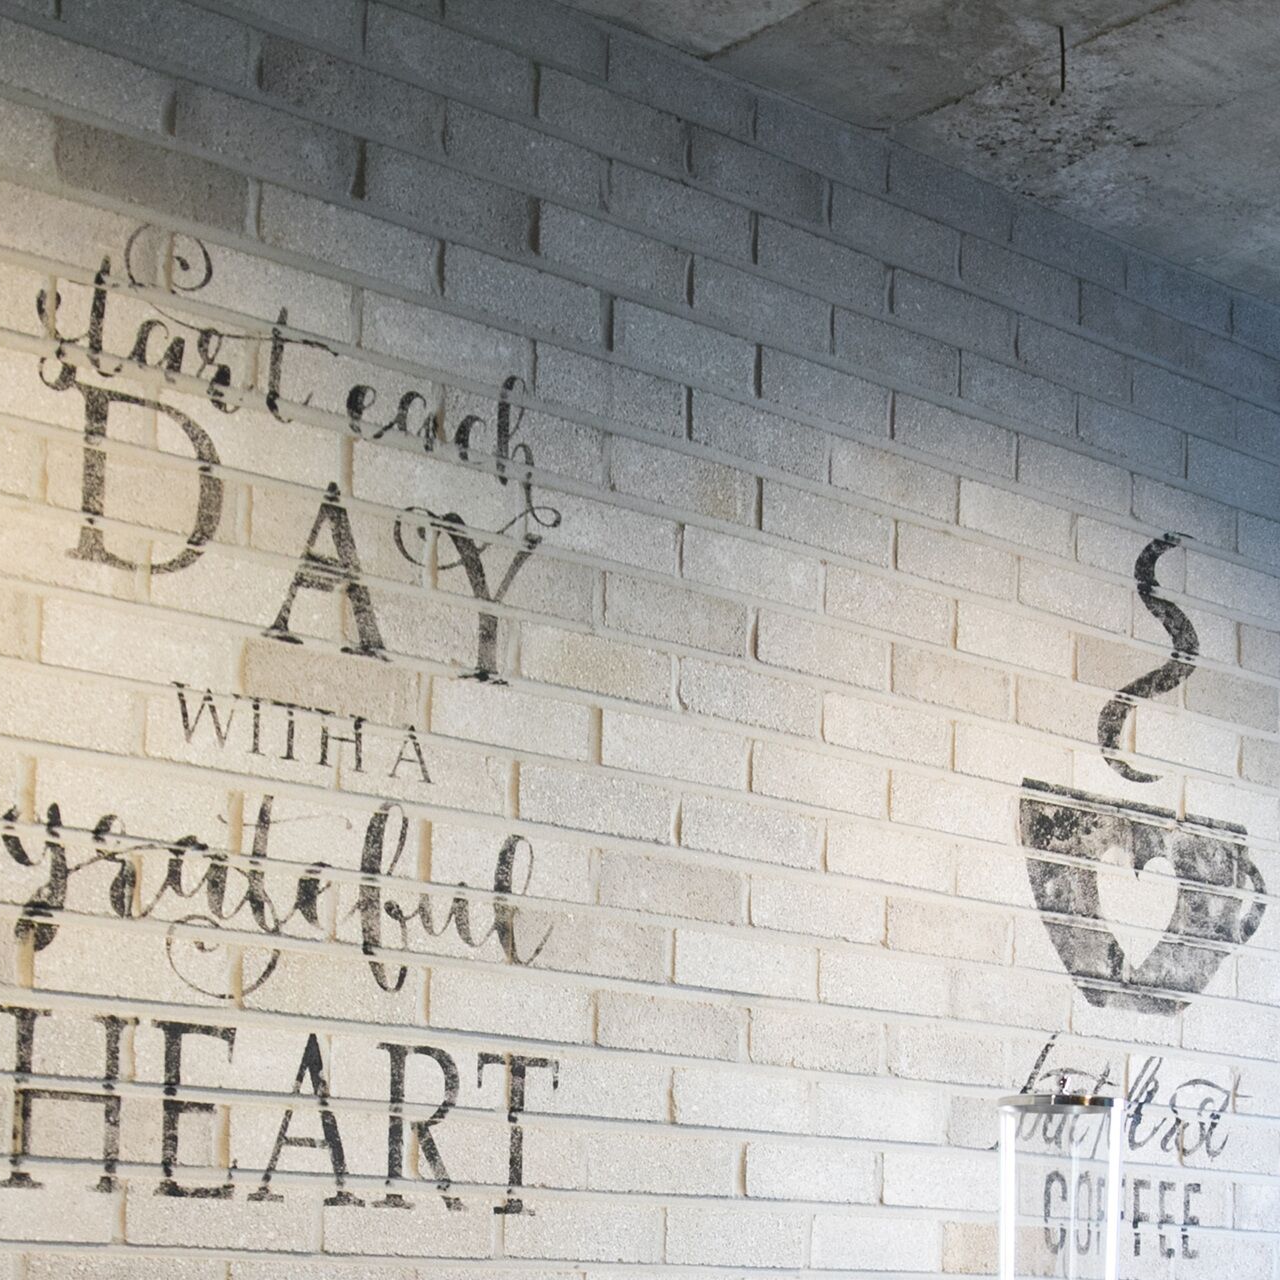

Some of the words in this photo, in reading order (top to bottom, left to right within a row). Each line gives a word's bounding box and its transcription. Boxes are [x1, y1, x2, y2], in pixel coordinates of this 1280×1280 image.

[65, 382, 543, 687] DAY
[171, 681, 366, 773] WITH
[388, 724, 434, 784] A
